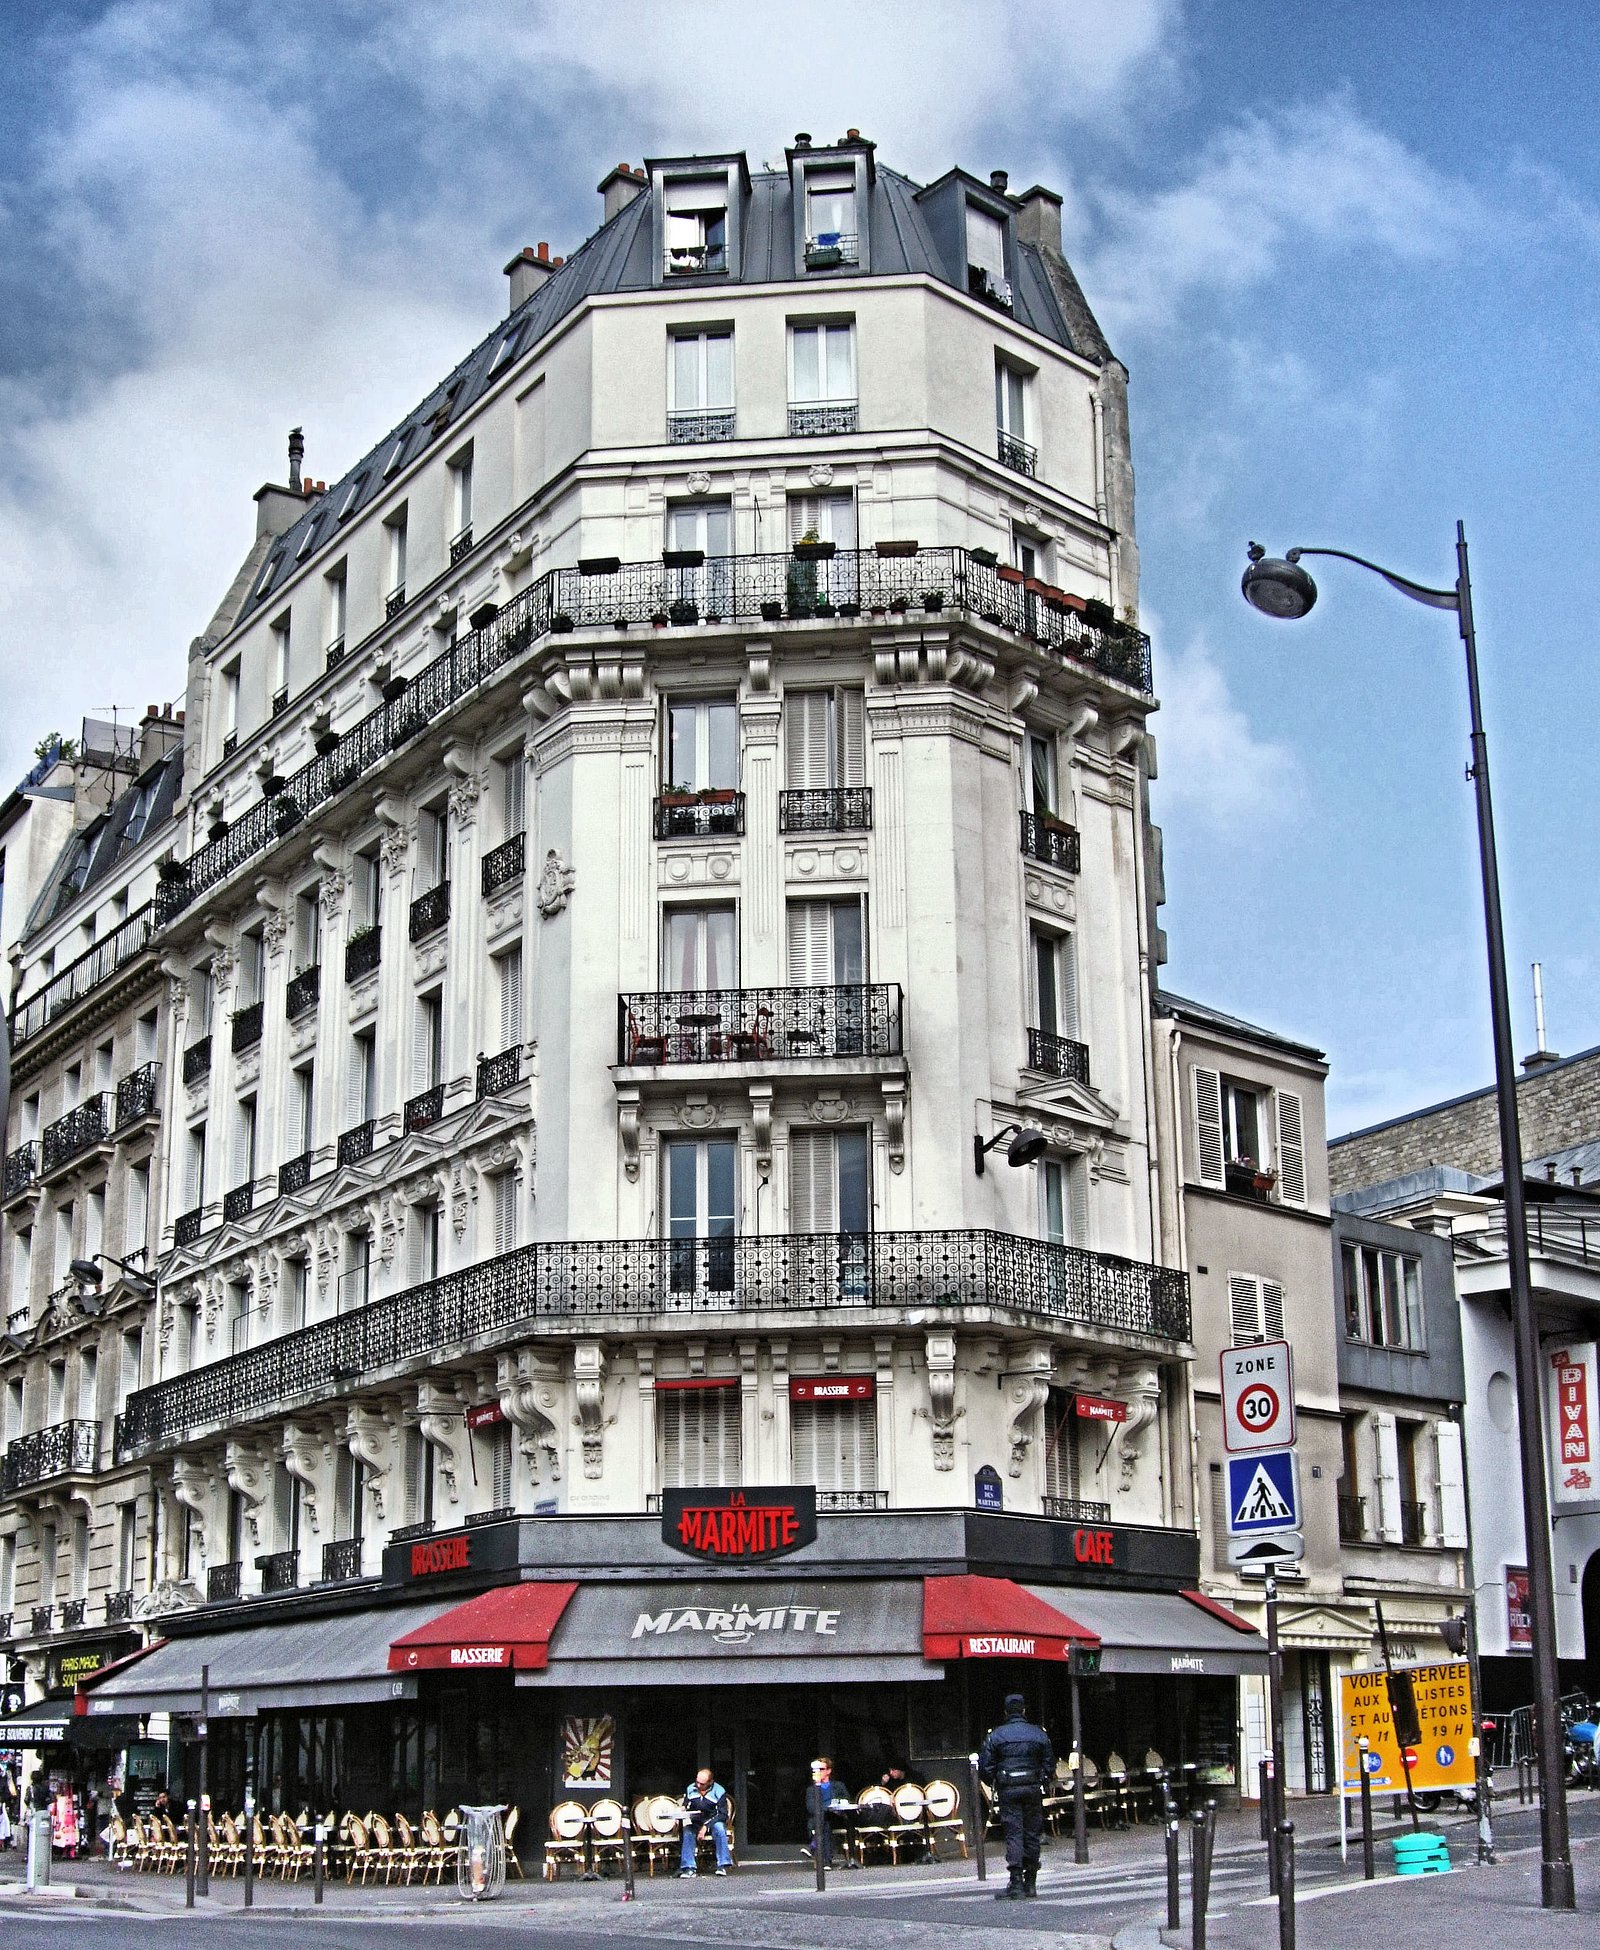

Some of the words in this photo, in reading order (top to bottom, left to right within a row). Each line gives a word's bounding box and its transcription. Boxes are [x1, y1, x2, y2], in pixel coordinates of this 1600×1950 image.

[1235, 1357, 1275, 1375] ZONE
[813, 1386, 849, 1396] BRASSERIE
[1090, 1405, 1113, 1418] MARMITE
[1245, 1397, 1271, 1419] 30
[1562, 1368, 1585, 1458] DIVAN
[730, 1491, 746, 1507] LA
[977, 1498, 1001, 1507] MARTYRS
[680, 1509, 800, 1554] MARMITE
[411, 1535, 470, 1576] BRASSERIE
[1075, 1529, 1114, 1565] CAFE
[731, 1603, 750, 1613] LA
[631, 1610, 841, 1638] MARMITE
[969, 1638, 1036, 1655] RESTAURANT
[61, 1657, 79, 1671] PARIS
[79, 1655, 100, 1669] MAGIC
[450, 1647, 505, 1664] BRASSERIE
[1171, 1657, 1204, 1672] MARMITE
[1350, 1674, 1383, 1689] VOIE
[1354, 1694, 1379, 1708] AUX
[1416, 1685, 1465, 1701] LISTES
[1350, 1714, 1366, 1727] ET
[1372, 1712, 1390, 1724] AU
[1421, 1703, 1468, 1719] ÉTONS
[7, 1728, 34, 1740] SOUVENIRS
[34, 1728, 43, 1740] DE
[43, 1727, 64, 1740] FRANCE
[1432, 1725, 1447, 1737] 19
[1454, 1723, 1464, 1735] H
